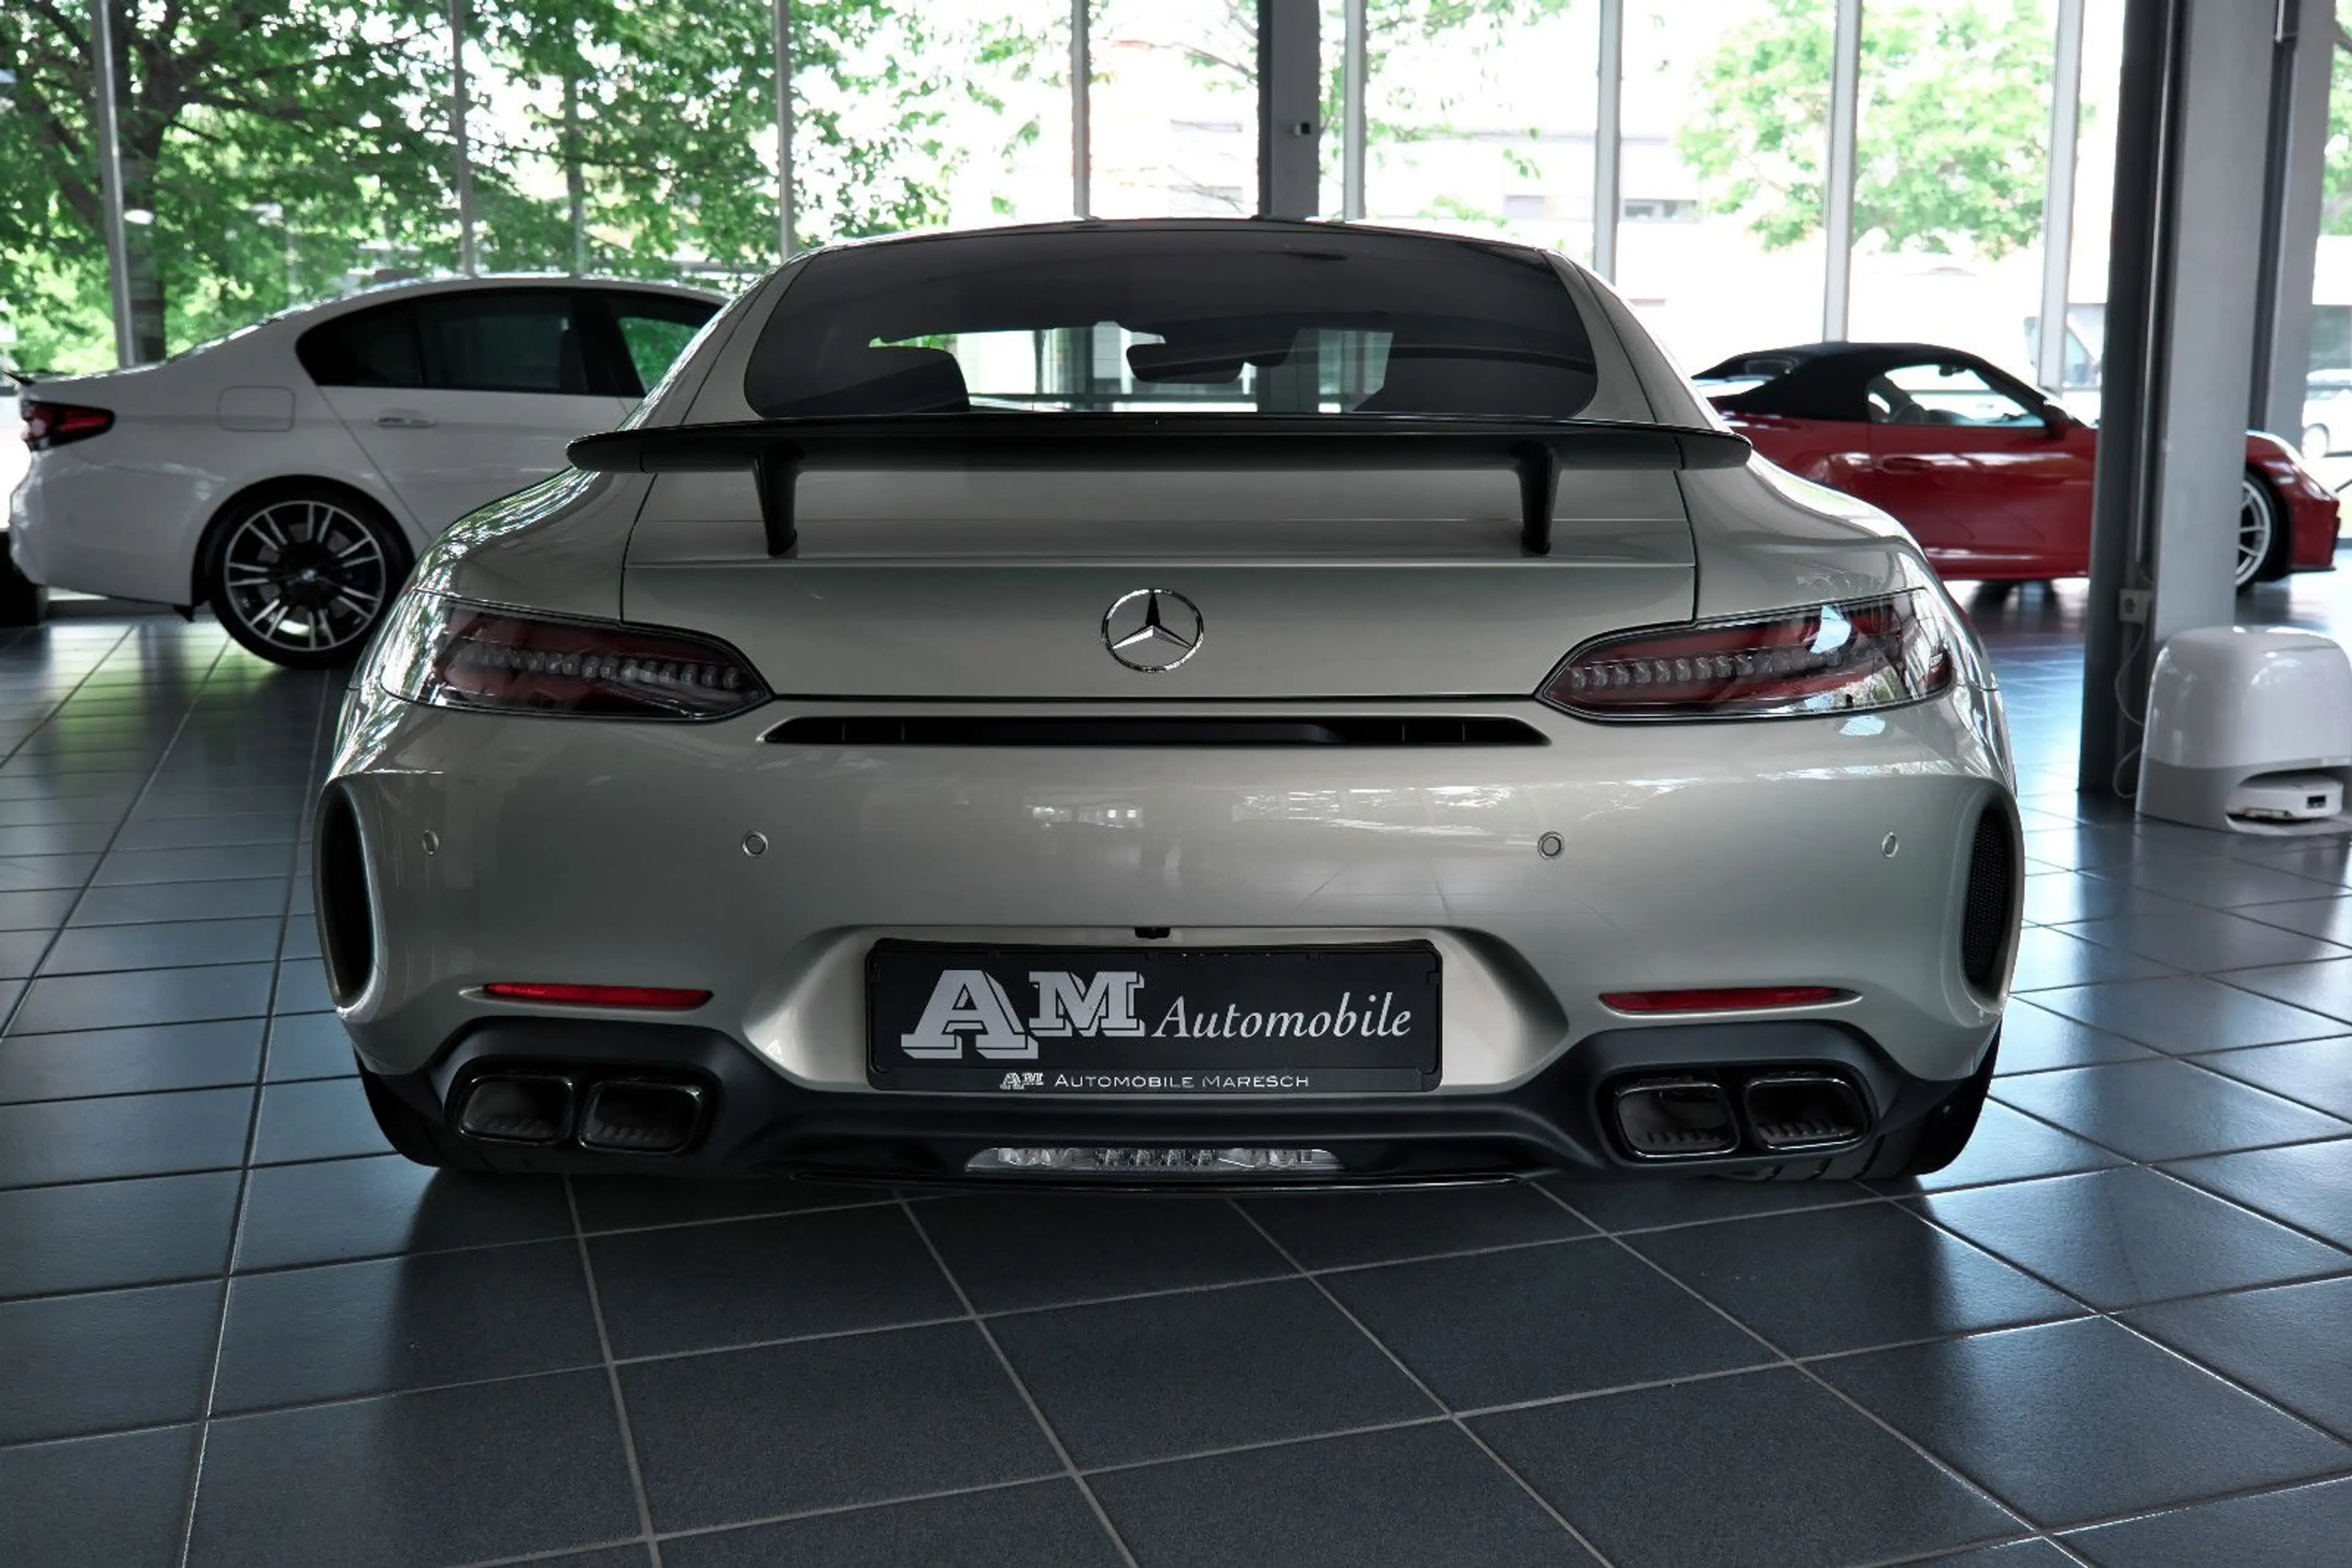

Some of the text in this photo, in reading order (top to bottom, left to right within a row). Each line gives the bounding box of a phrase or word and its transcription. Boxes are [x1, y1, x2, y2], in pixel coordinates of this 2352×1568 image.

[900, 970, 1411, 1059] AM Automobile
[999, 1072, 1309, 1090] AM AUTOMOBILE MARESCH
